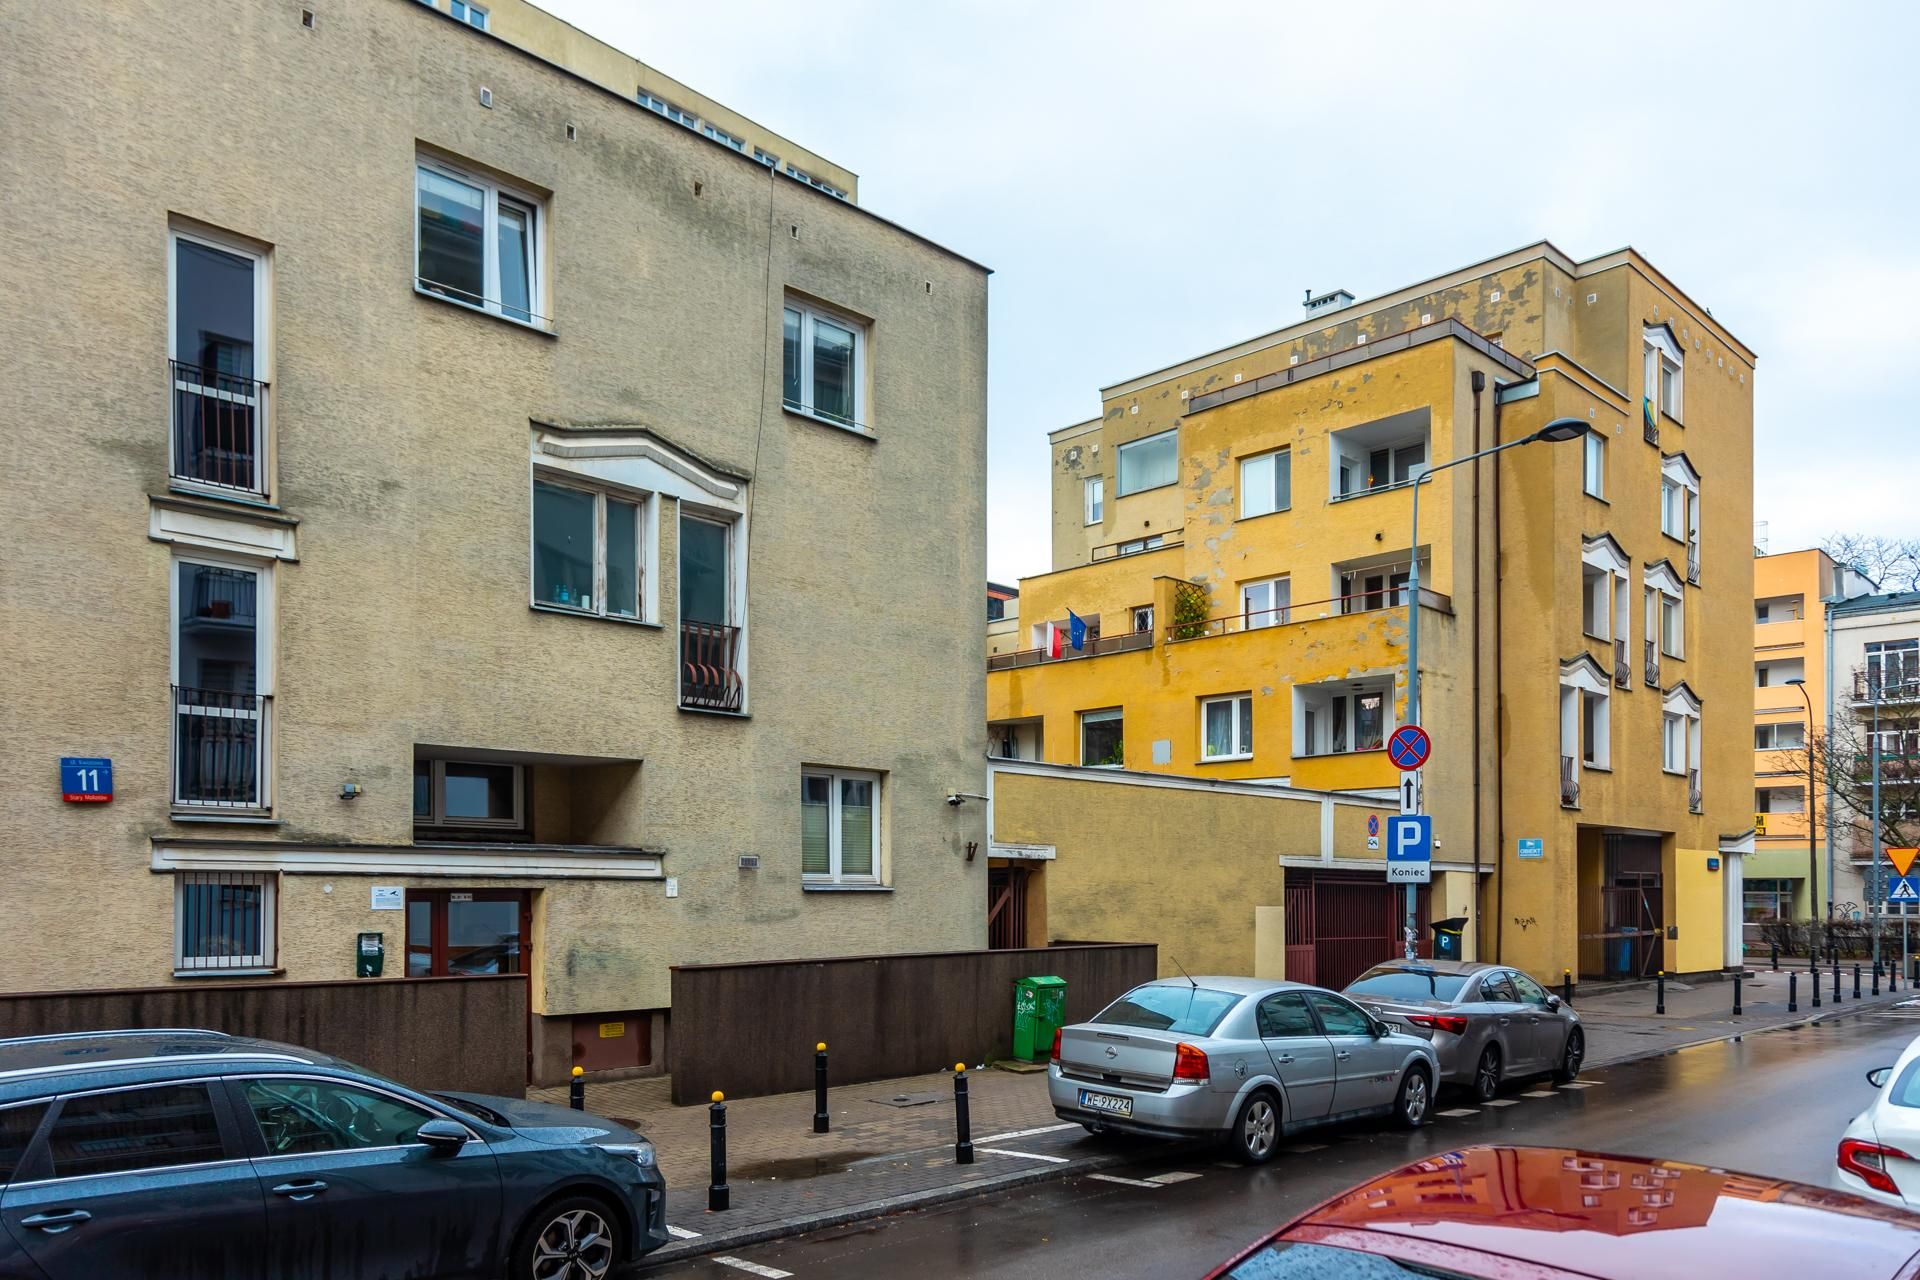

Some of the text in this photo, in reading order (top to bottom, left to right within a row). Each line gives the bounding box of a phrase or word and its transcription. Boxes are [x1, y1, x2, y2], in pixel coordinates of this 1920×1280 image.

[76, 768, 99, 792] 11
[1397, 821, 1422, 856] P
[1391, 867, 1425, 877] Koniec
[1441, 935, 1449, 947] P
[1087, 1093, 1130, 1111] WE 9X224
